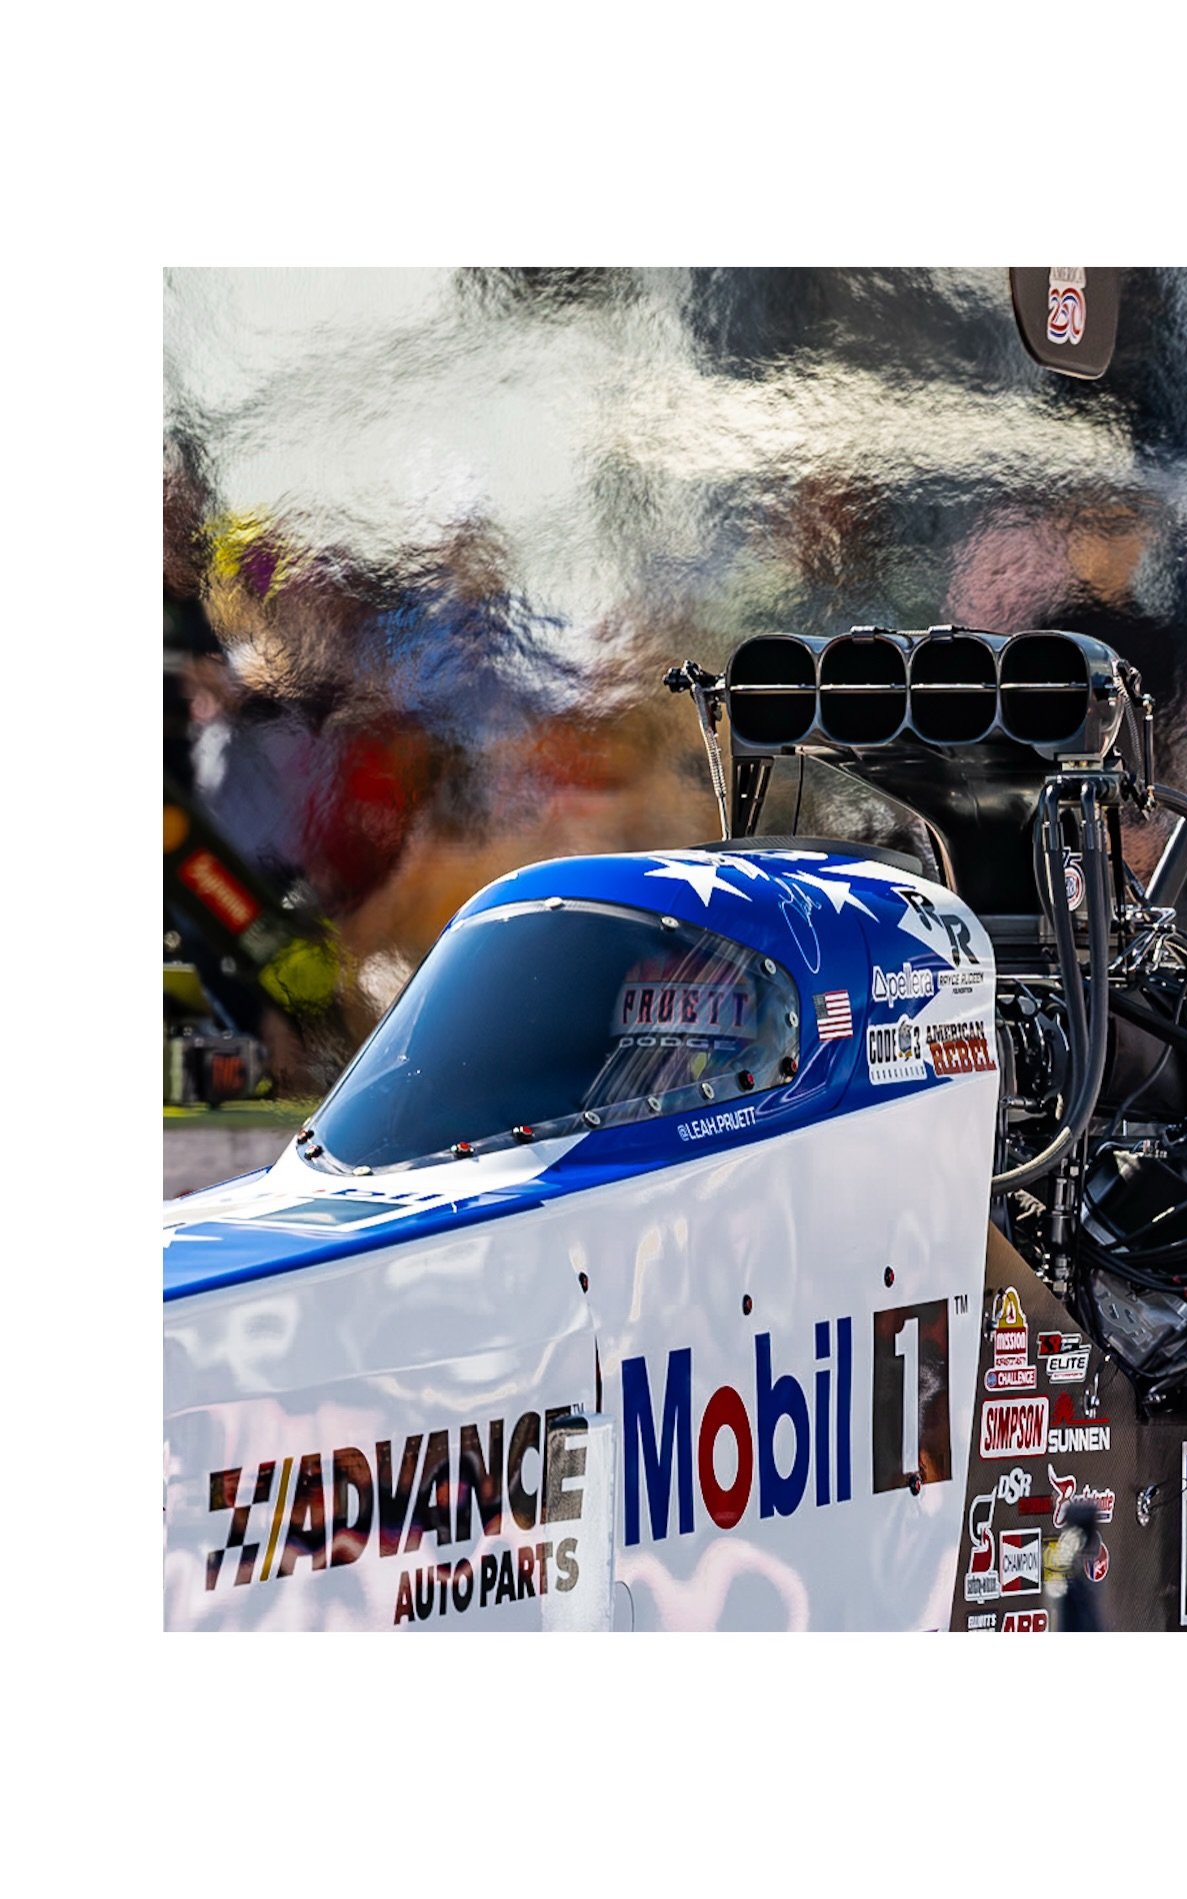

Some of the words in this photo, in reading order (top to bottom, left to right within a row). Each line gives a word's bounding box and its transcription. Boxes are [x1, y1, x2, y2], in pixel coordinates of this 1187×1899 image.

[622, 988, 748, 1027] PRUETT
[619, 1036, 737, 1051] DODGE
[869, 1028, 897, 1065] CODE
[913, 1025, 921, 1060] 3
[926, 1020, 985, 1044] AMERICAN
[929, 1039, 998, 1076] REBEL
[997, 1371, 1035, 1386] CHALLENGE
[1049, 1357, 1086, 1370] ELITE
[621, 1316, 852, 1546] Mobil
[984, 1404, 1045, 1452] SIMPSON
[1047, 1427, 1111, 1454] SUNNEN
[276, 1404, 589, 1579] ADVANCE
[997, 1467, 1033, 1505] DSR
[393, 1556, 475, 1625] AUTO
[480, 1536, 581, 1608] PARTS
[1003, 1551, 1038, 1573] CHAMPION
